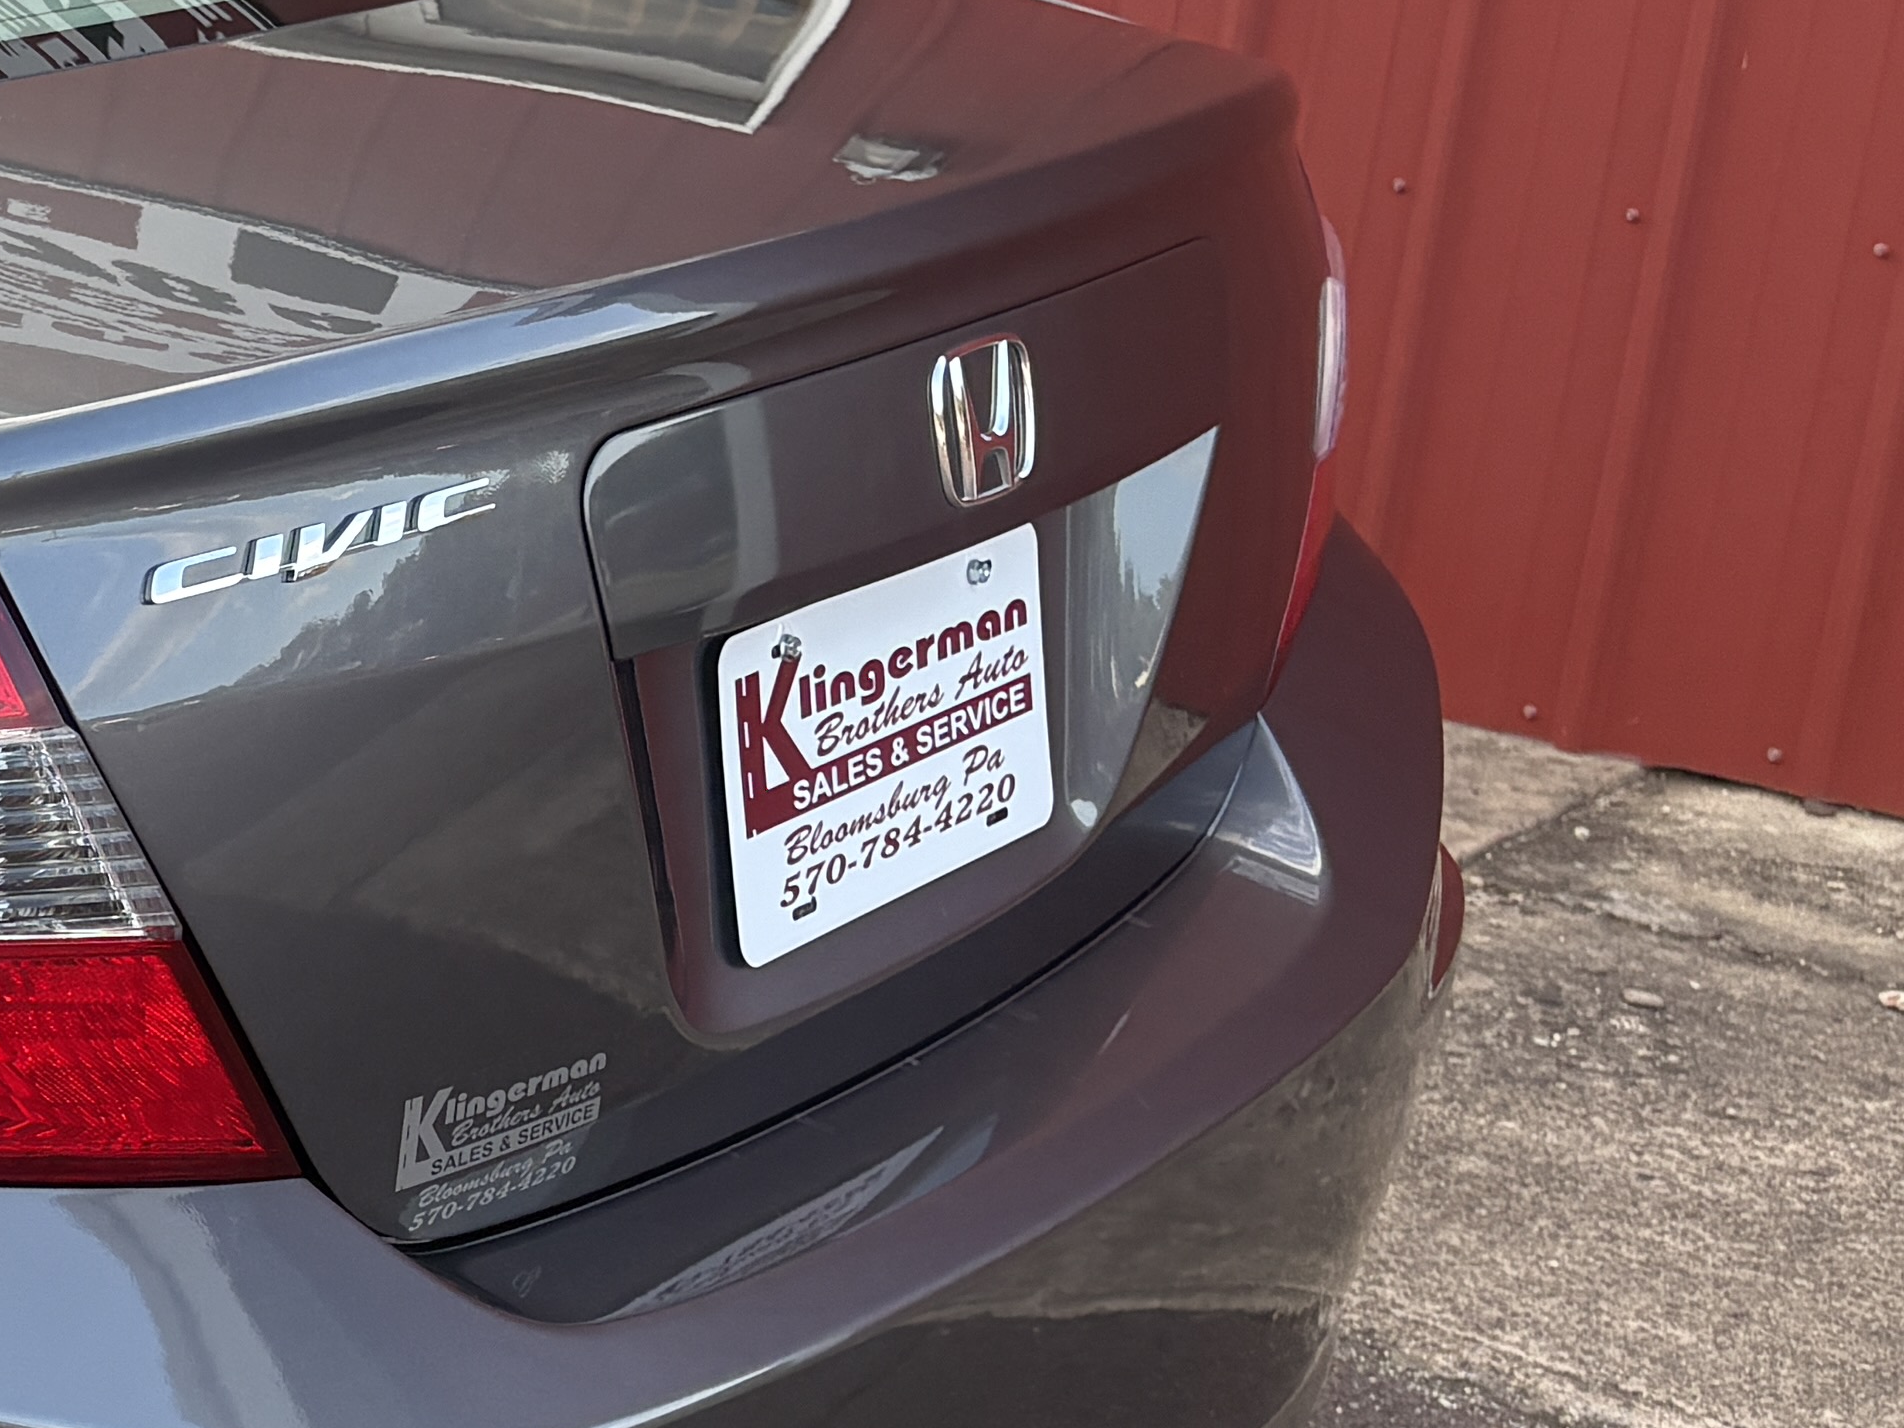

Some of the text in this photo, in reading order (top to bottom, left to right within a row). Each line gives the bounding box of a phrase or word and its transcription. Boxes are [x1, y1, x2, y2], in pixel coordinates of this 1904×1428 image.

[140, 476, 496, 605] CIVIC
[735, 599, 1028, 839] Klingerman
[793, 682, 1026, 810] SALES & SERVICE
[814, 646, 1029, 756] Brothers Auto
[780, 774, 1016, 908] 570-784-4220
[784, 745, 1005, 864] Bloomsburg Pa
[395, 1052, 607, 1192] Klingerman
[431, 1103, 594, 1175] SALES & SERVICE
[451, 1080, 601, 1147] Brothers Auto
[408, 1157, 577, 1233] 570-784-4220
[418, 1154, 533, 1208] Bloomsburg
